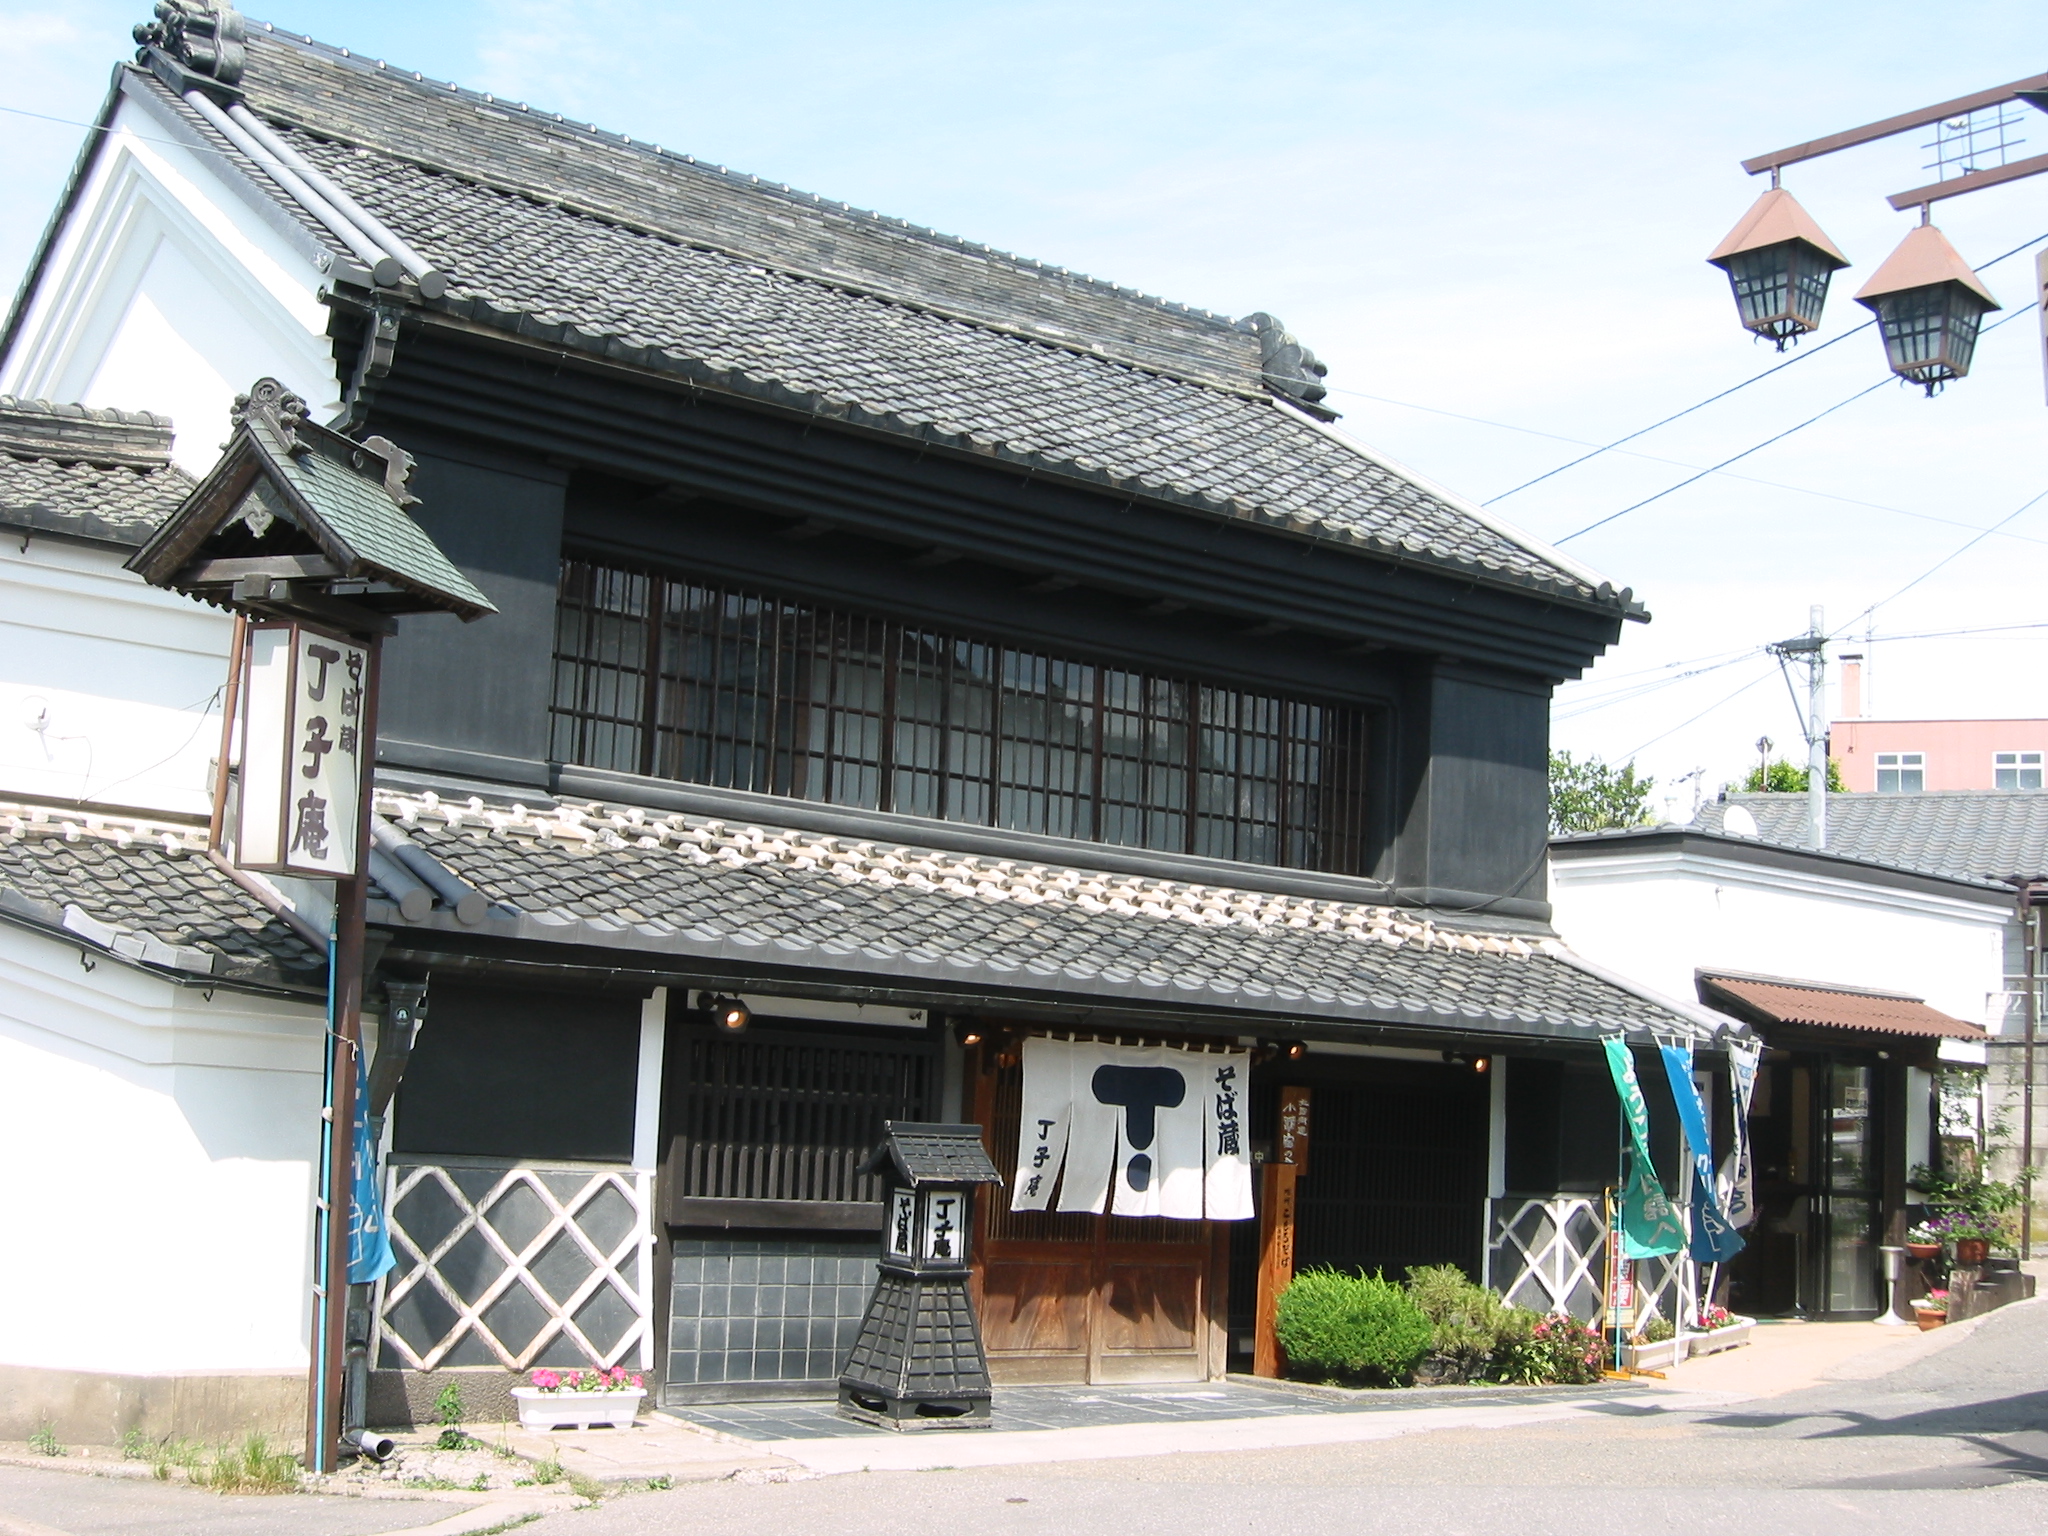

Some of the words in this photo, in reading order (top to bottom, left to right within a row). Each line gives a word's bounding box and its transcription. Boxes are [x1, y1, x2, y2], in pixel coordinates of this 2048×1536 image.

[290, 643, 340, 861] 丁子庵
[1214, 1064, 1241, 1157] そば蔵
[1025, 1118, 1057, 1198] 丁子庵
[932, 1198, 956, 1258] 丁子庵
